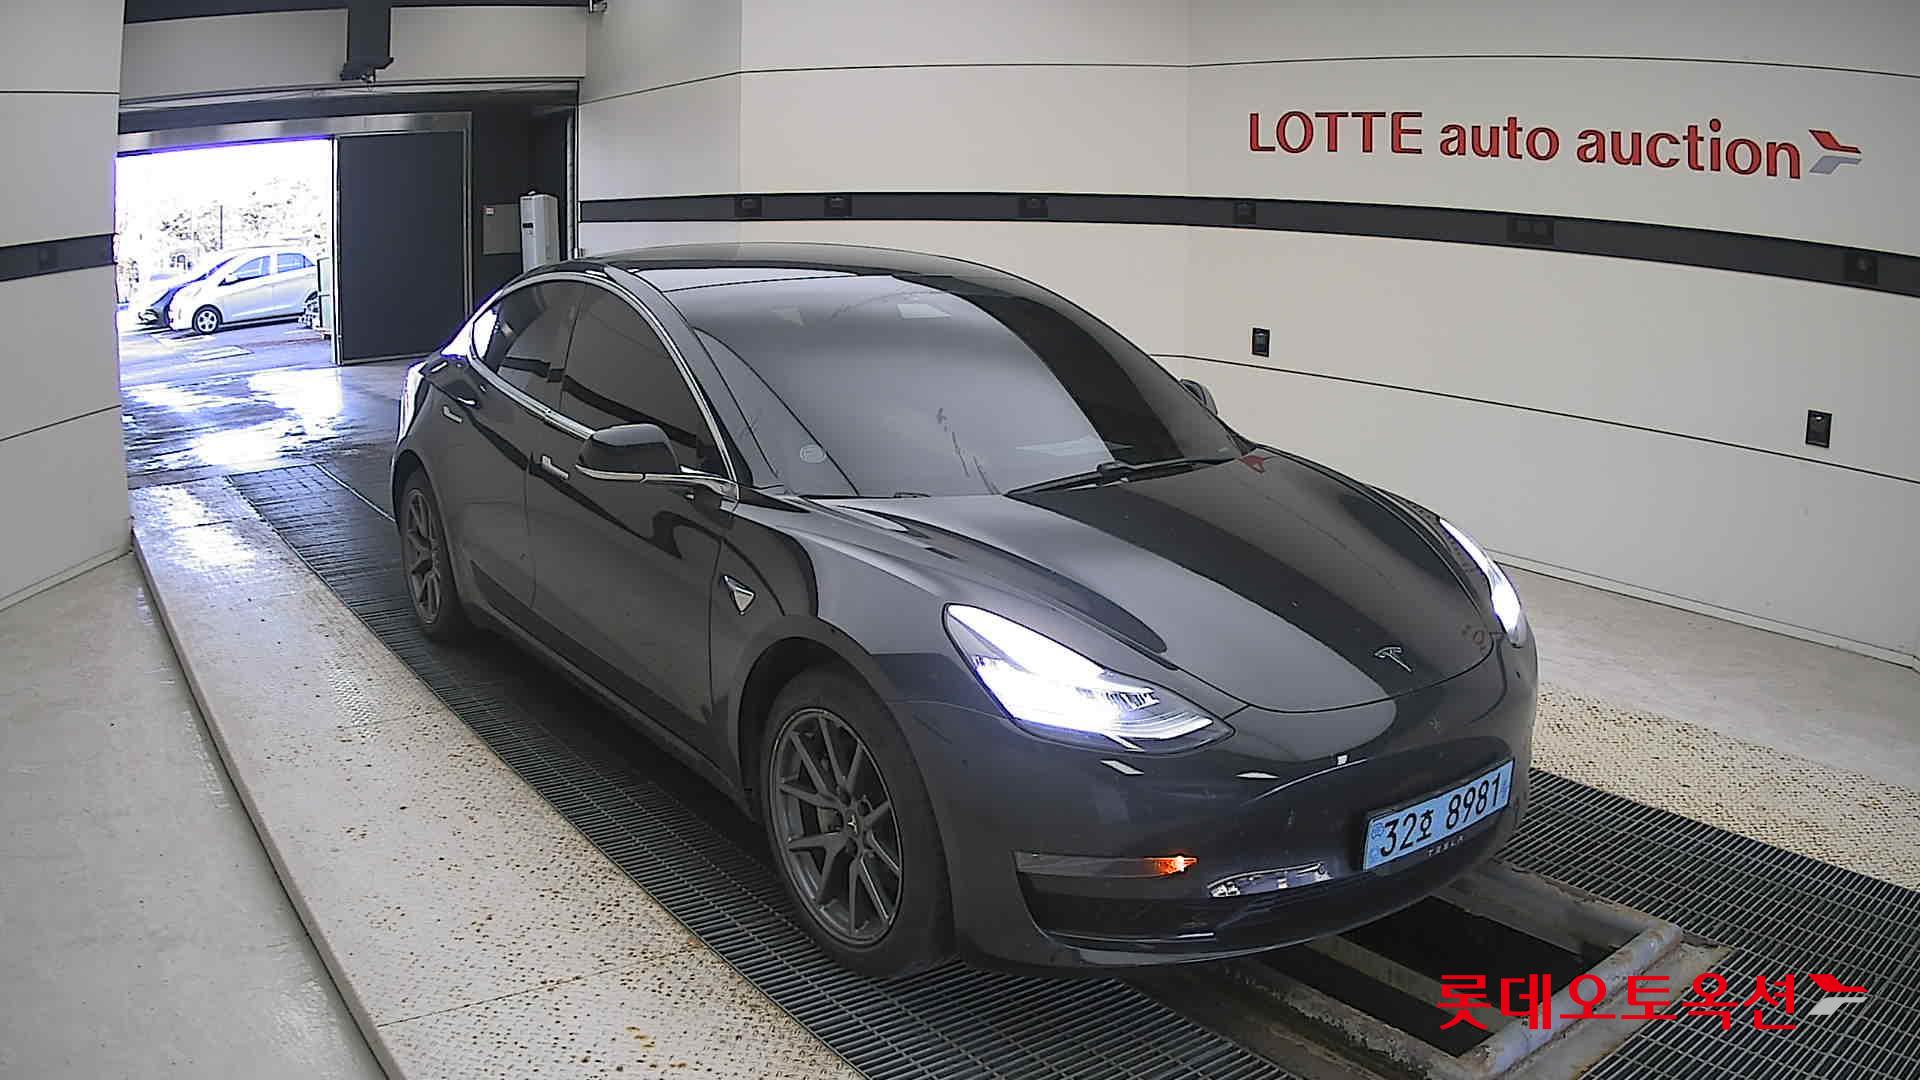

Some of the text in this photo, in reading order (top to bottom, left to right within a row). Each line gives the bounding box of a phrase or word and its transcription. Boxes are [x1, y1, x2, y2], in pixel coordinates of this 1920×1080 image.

[1249, 110, 1801, 180] LOTTE auto auction
[1380, 772, 1502, 857] 32호 8981
